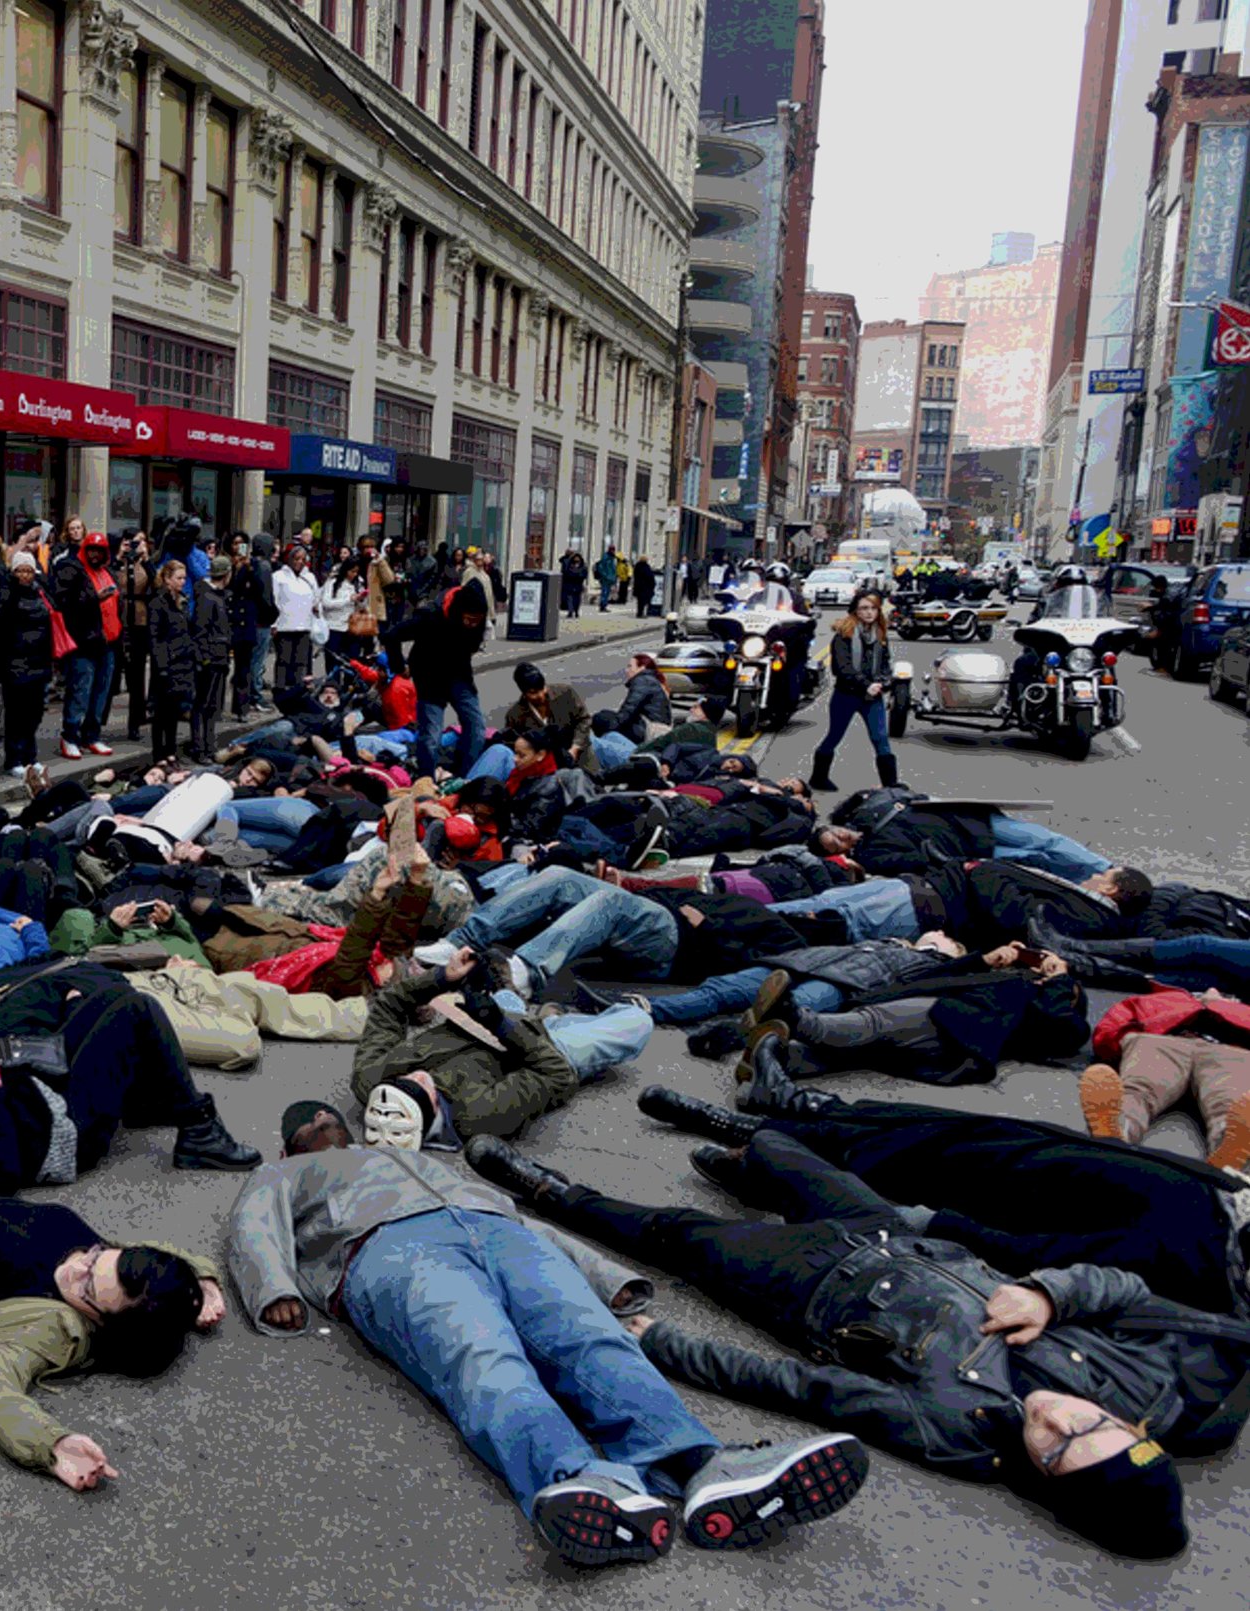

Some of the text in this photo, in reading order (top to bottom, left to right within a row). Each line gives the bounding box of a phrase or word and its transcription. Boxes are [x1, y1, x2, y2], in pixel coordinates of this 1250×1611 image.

[18, 393, 72, 425] Burlington
[84, 403, 132, 434] Burlington
[322, 443, 345, 470] RITE
[345, 448, 362, 472] AID
